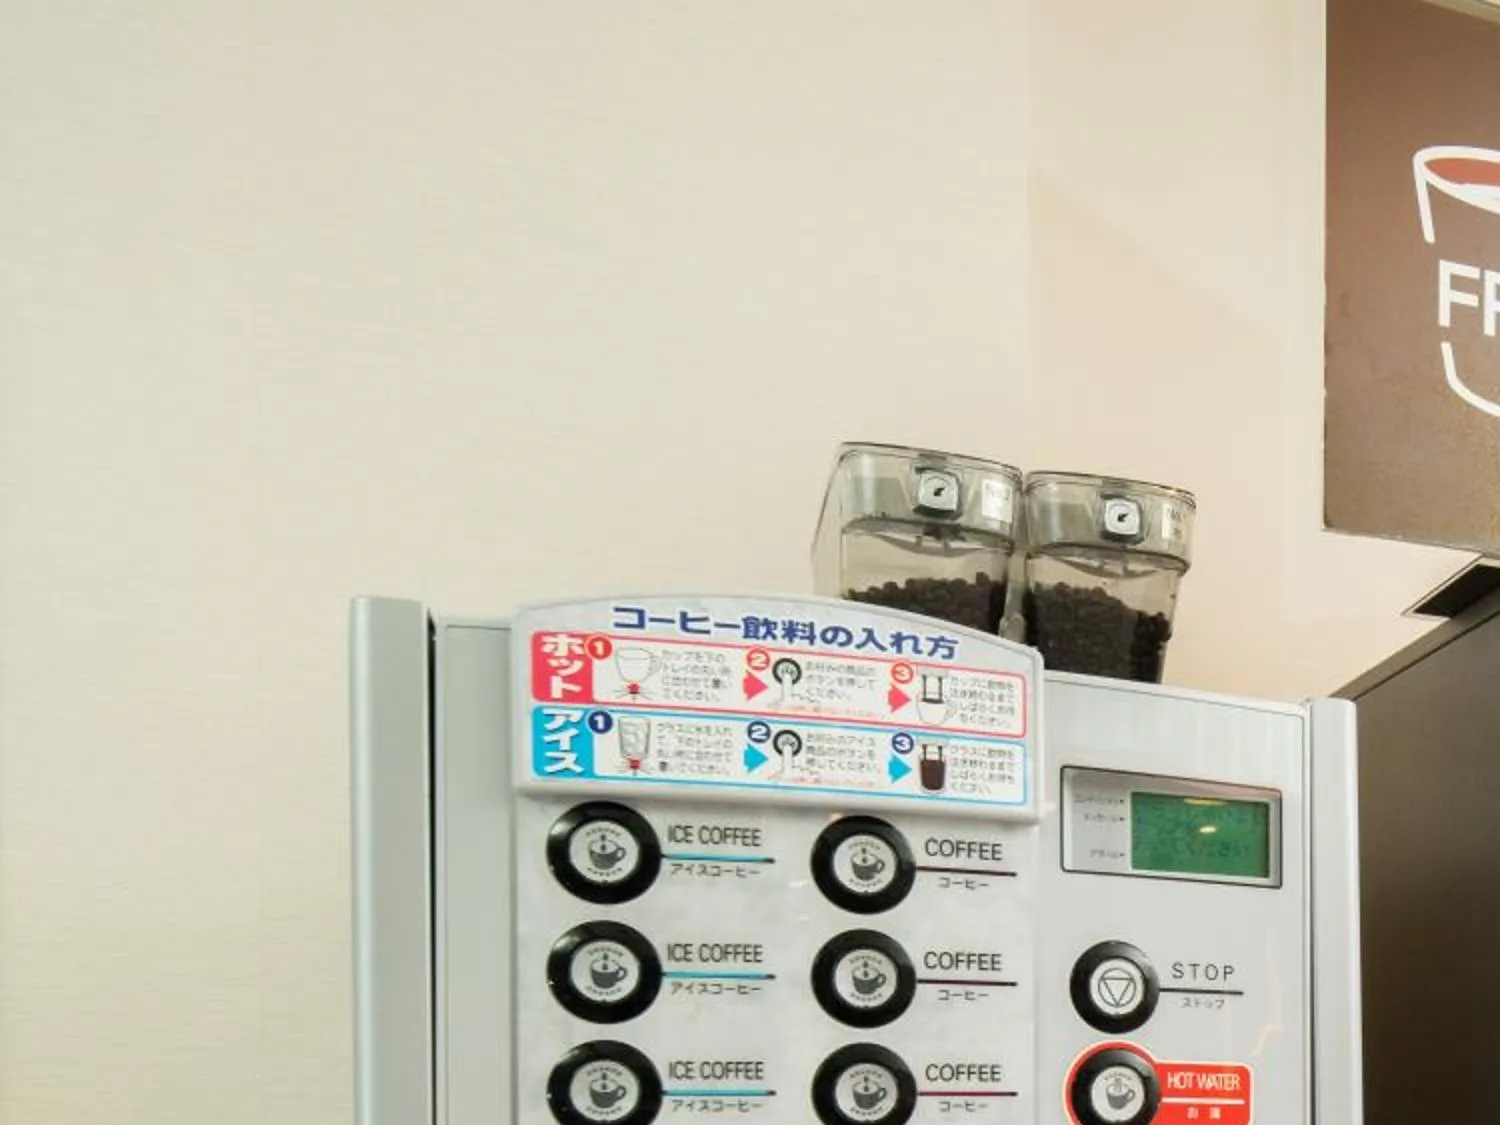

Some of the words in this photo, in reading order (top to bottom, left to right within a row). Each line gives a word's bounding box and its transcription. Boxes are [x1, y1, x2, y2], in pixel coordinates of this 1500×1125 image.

[612, 605, 960, 660] コーヒー飲料の入れ方
[541, 634, 585, 699] ホット
[542, 708, 585, 774] アイス
[667, 826, 696, 847] ICE
[699, 826, 762, 848] COFFEE
[924, 838, 1004, 862] COFFEE
[670, 863, 761, 879] アイスコーヒー
[938, 877, 990, 890] コーヒー
[667, 944, 696, 963] ICE
[699, 944, 764, 964] COFFEE
[923, 952, 1003, 973] COFFEE
[1171, 962, 1236, 982] STOP
[670, 983, 763, 997] アイスコーヒー
[938, 989, 990, 1002] コーヒー
[668, 1061, 697, 1080] ICE
[699, 1061, 765, 1082] COFFEE
[925, 1063, 1003, 1084] COFFEE
[1167, 1072, 1195, 1089] HOT
[1197, 1073, 1240, 1091] WATER
[670, 1099, 763, 1114] アイスコーヒー
[939, 1101, 989, 1114] コーヒー
